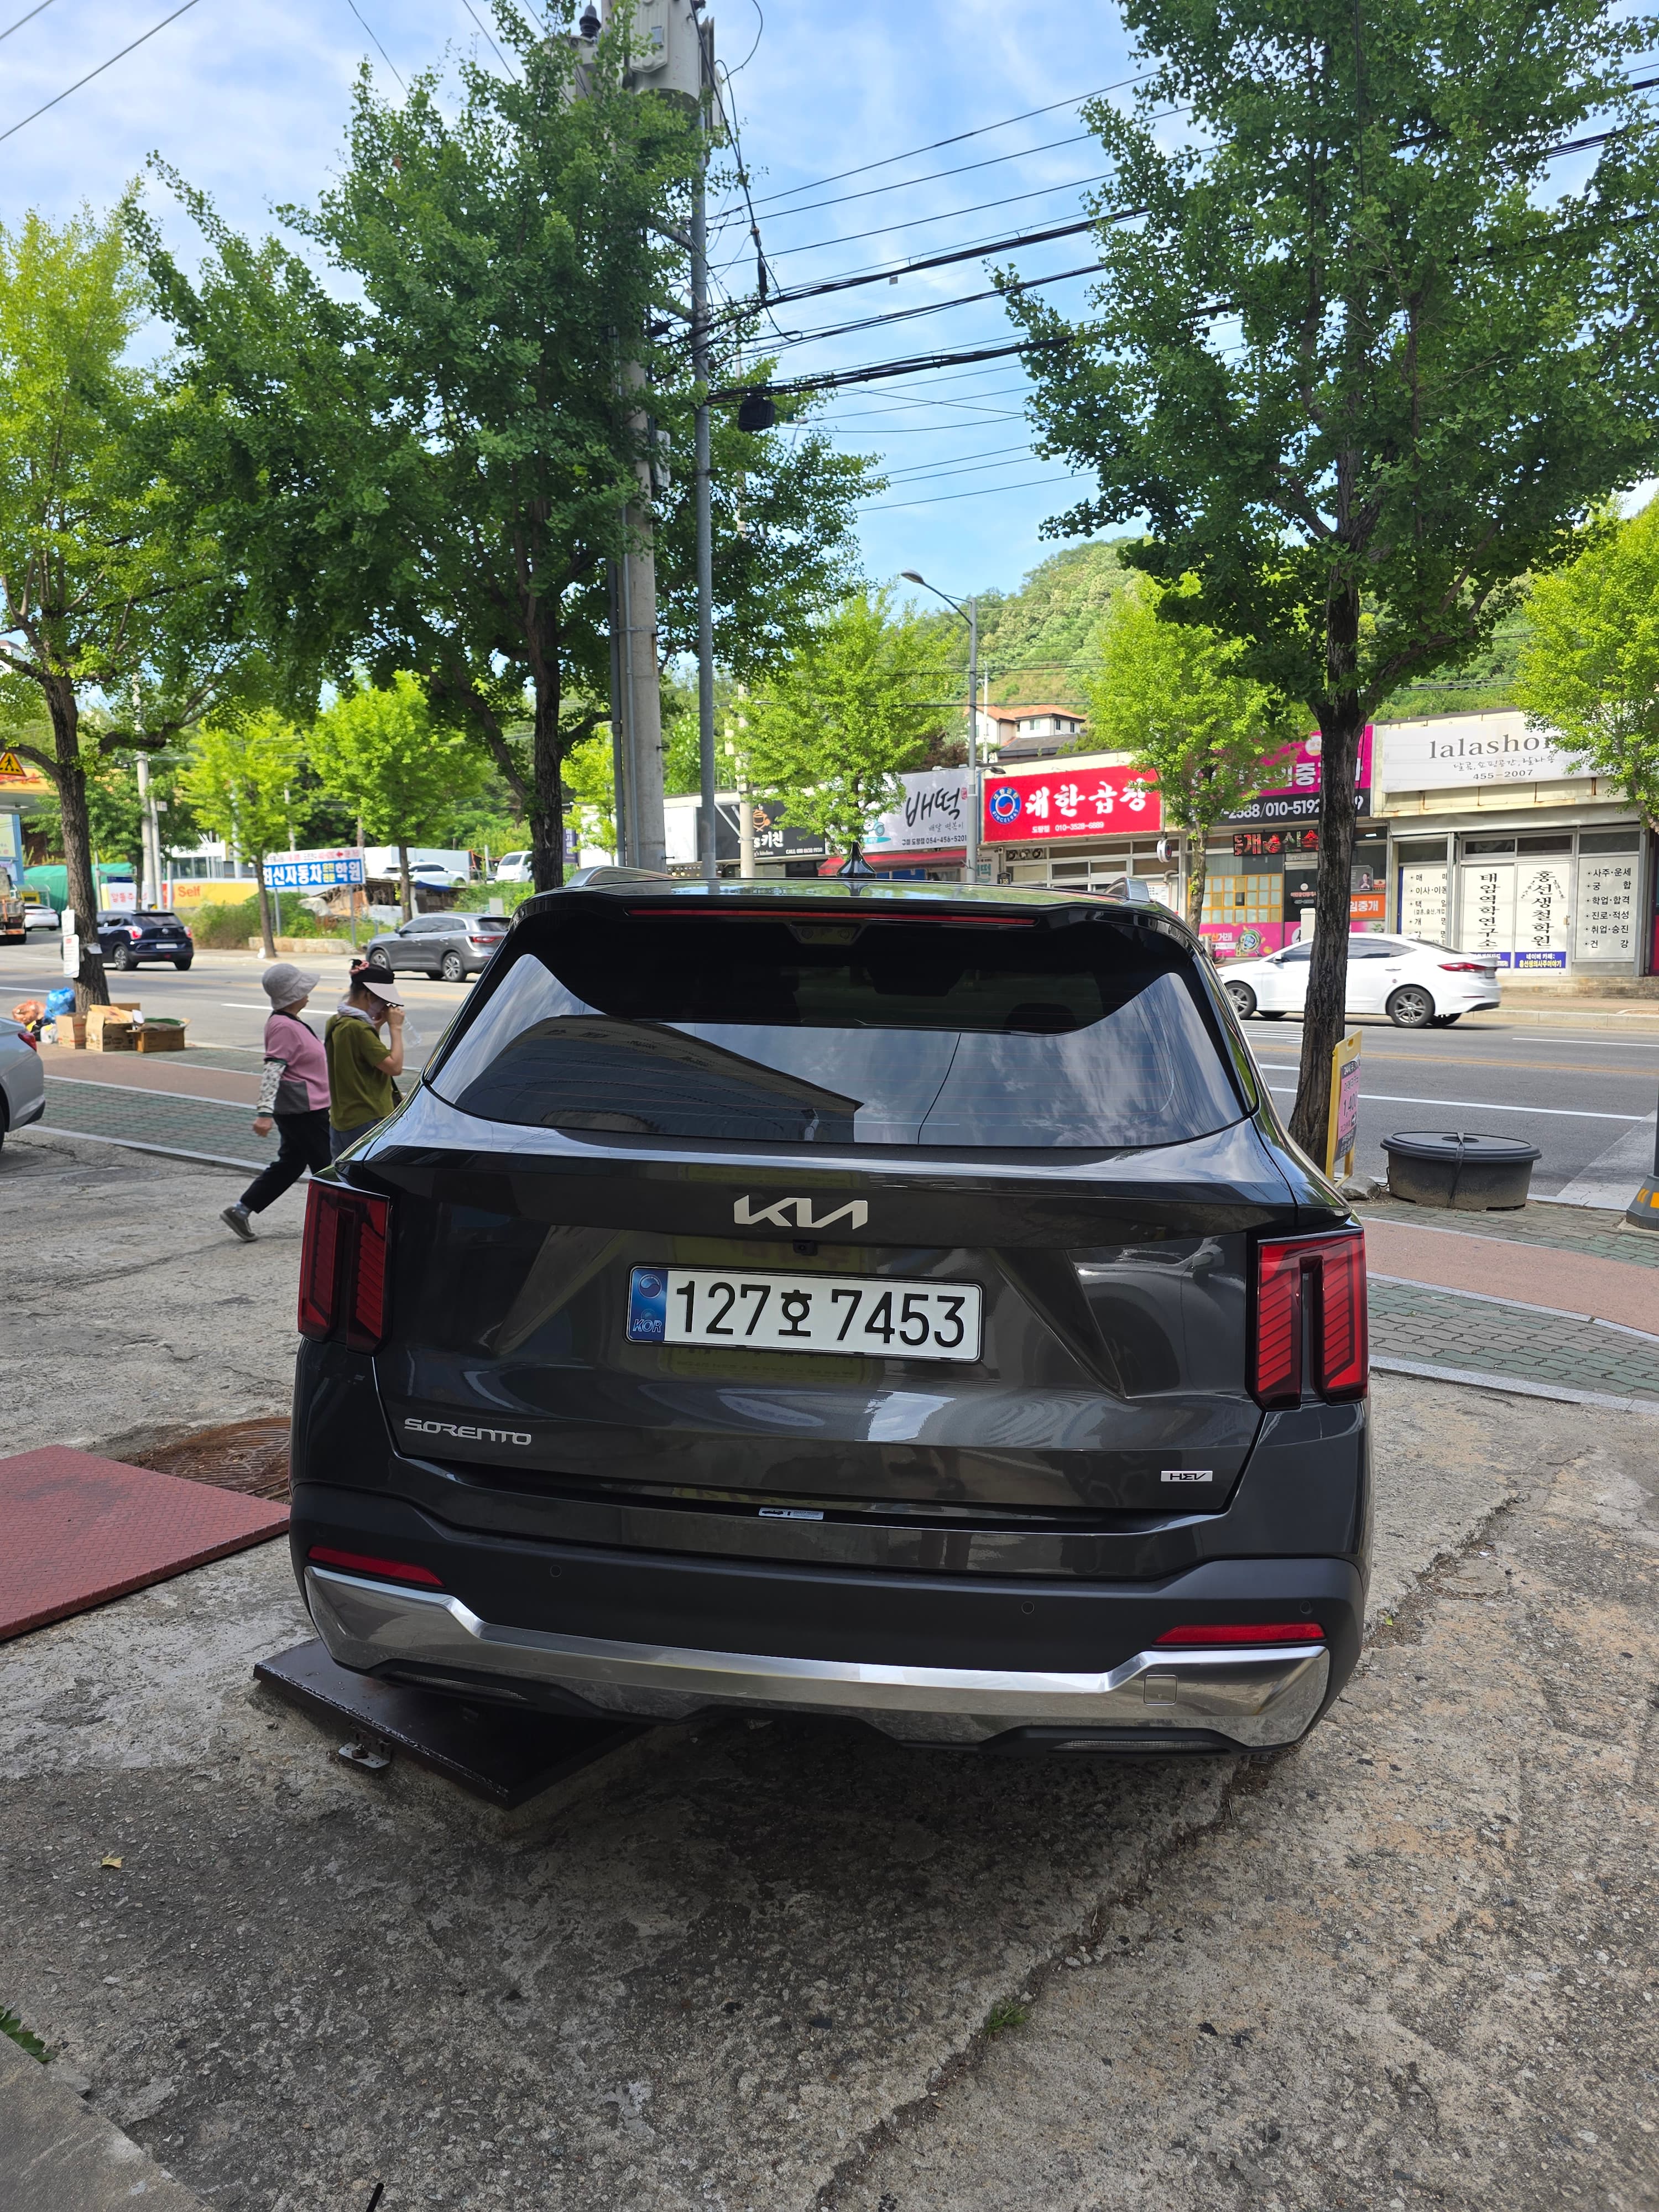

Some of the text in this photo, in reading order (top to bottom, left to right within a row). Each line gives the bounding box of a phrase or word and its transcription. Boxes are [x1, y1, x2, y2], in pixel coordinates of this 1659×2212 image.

[1428, 734, 1576, 759] lalashon
[1473, 769, 1533, 780] 455-2007
[905, 787, 961, 827] 배떡
[335, 861, 361, 882] 학원
[178, 885, 201, 898] Self
[1592, 880, 1631, 891] 궁 합
[1477, 873, 1501, 947] 태암역학연구소
[1530, 870, 1556, 947] 홍선생철학원
[1590, 940, 1629, 948] 건 강
[632, 1318, 662, 1333] KOR
[676, 1280, 966, 1348] 127호 7453
[404, 1418, 531, 1446] SORENTO
